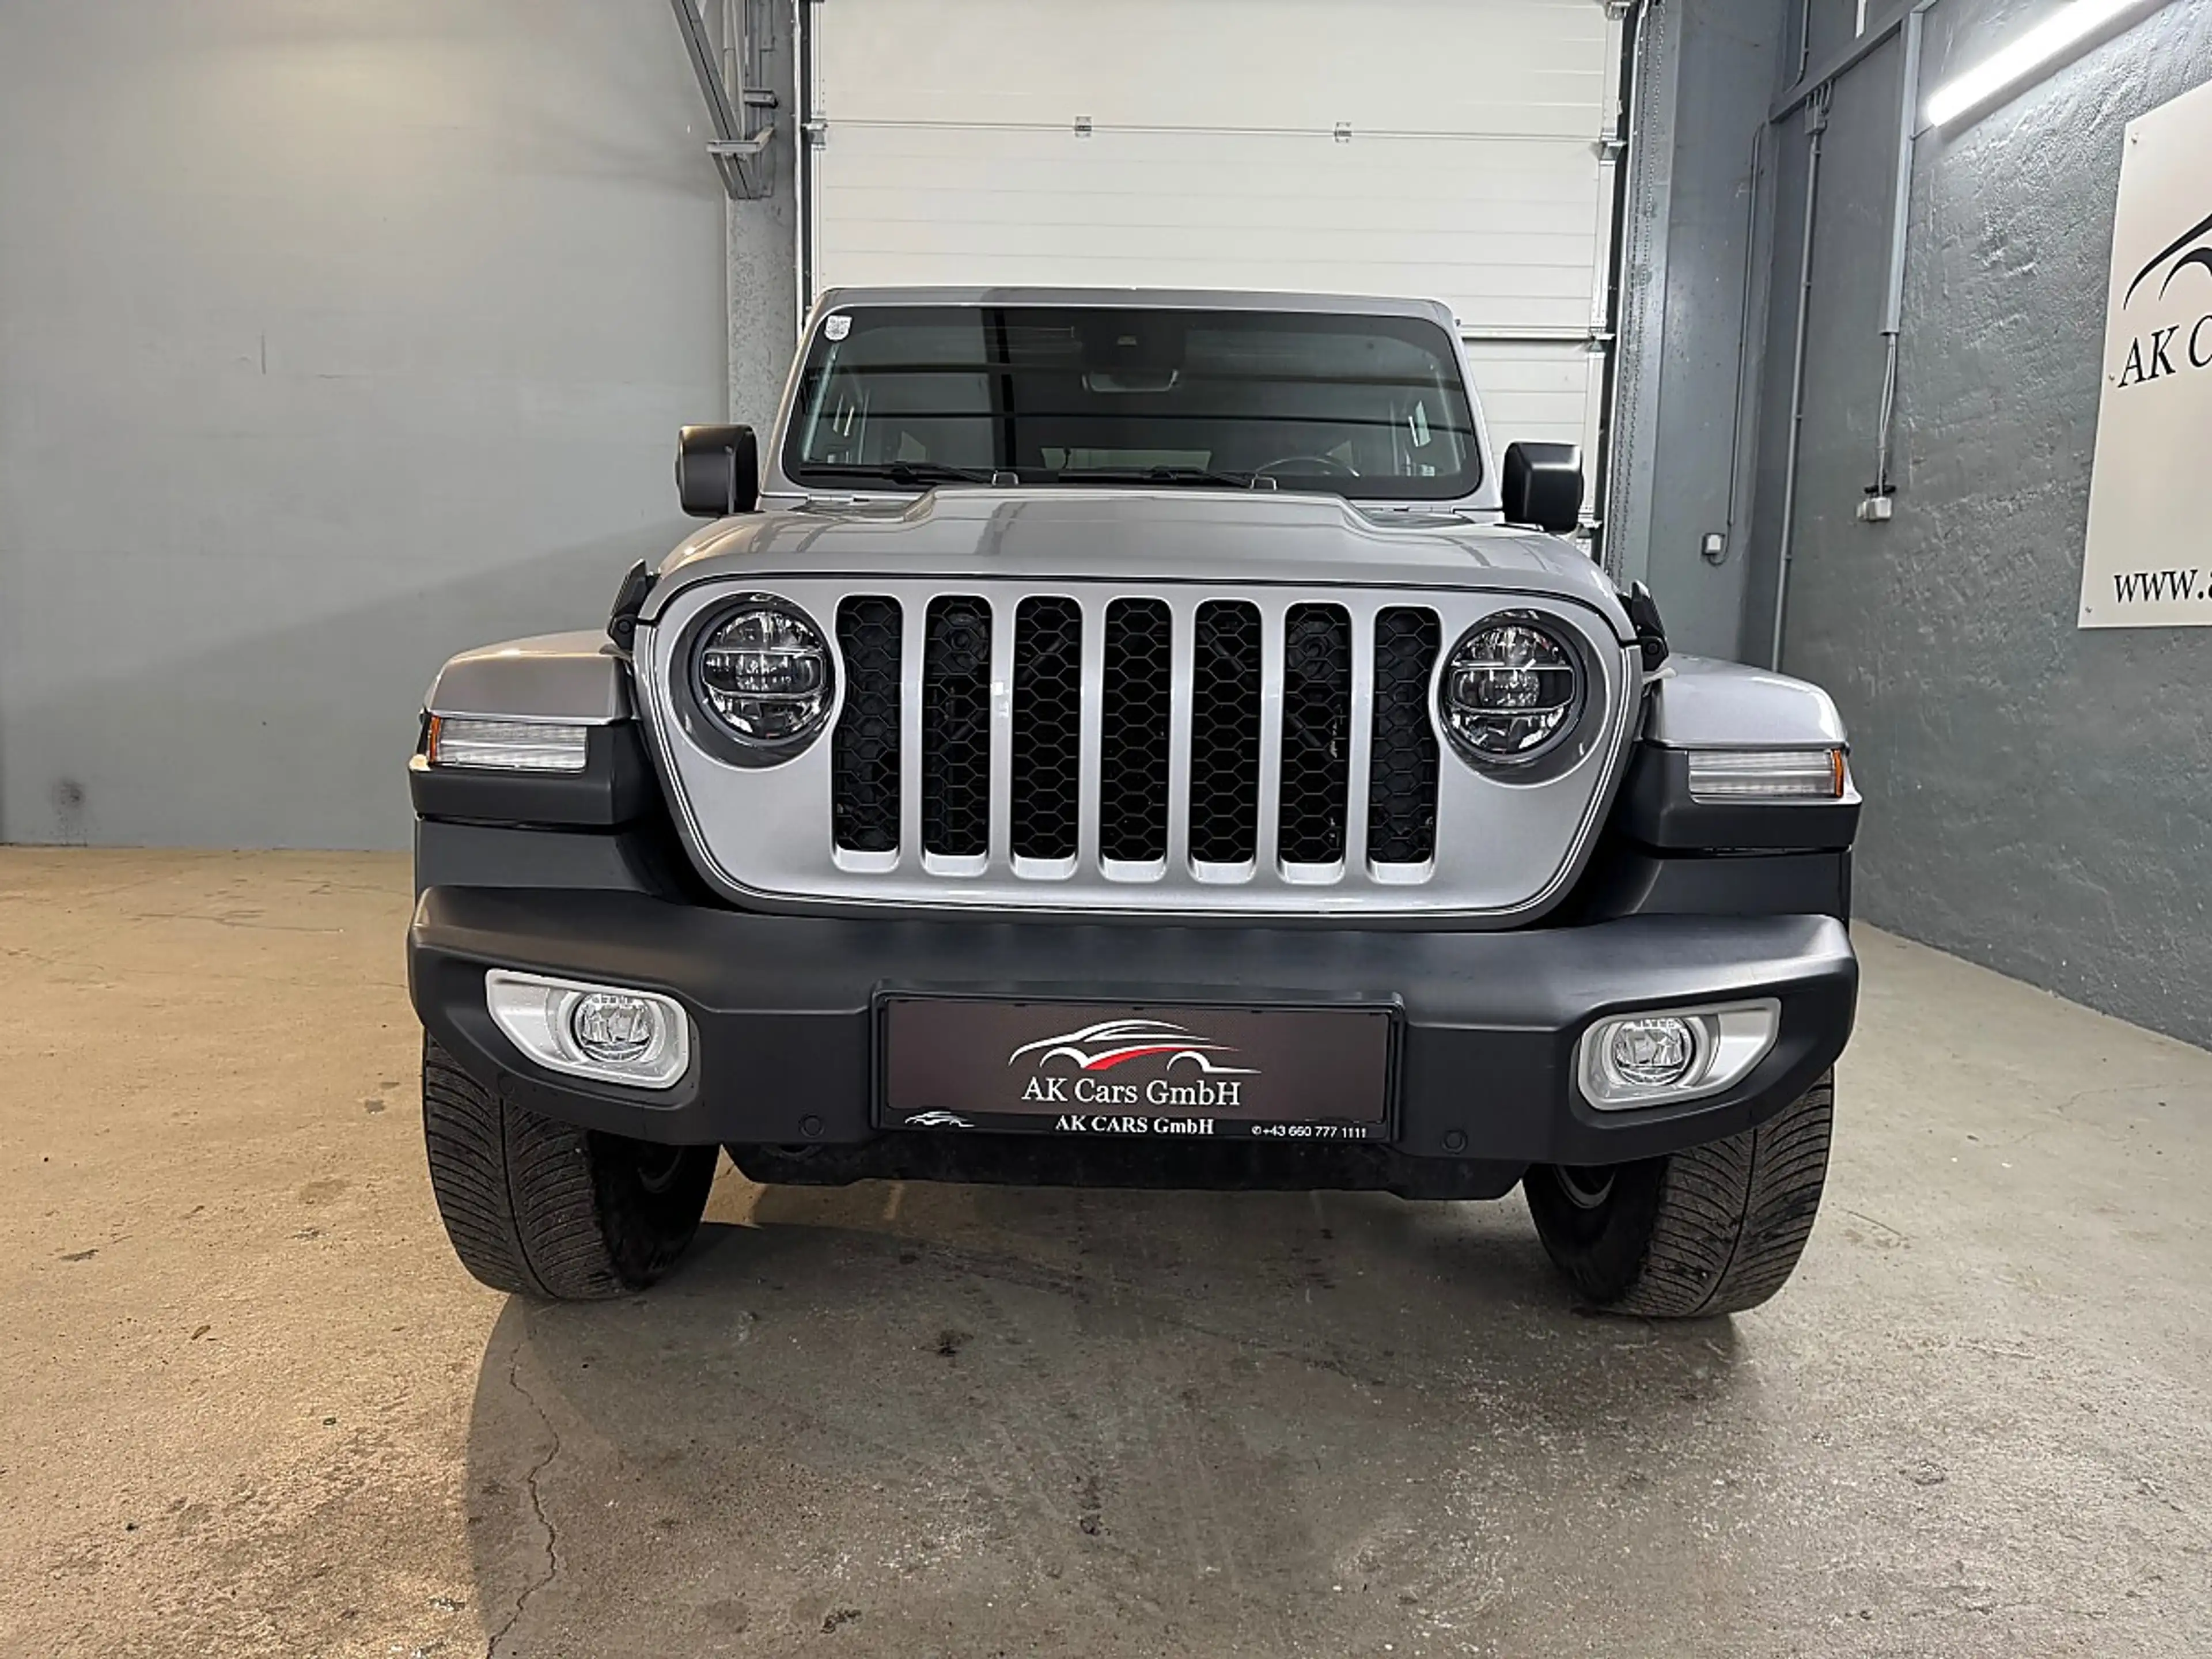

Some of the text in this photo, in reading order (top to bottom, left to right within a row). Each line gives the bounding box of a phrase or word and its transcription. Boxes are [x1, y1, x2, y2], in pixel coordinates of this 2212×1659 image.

[2117, 324, 2180, 388] AK
[2113, 569, 2212, 603] www.
[1021, 1076, 1241, 1106] AK Cars GmbH
[1055, 1115, 1214, 1135] AK CARS GmbH
[1315, 1126, 1338, 1138] 777
[1342, 1127, 1367, 1138] 1111
